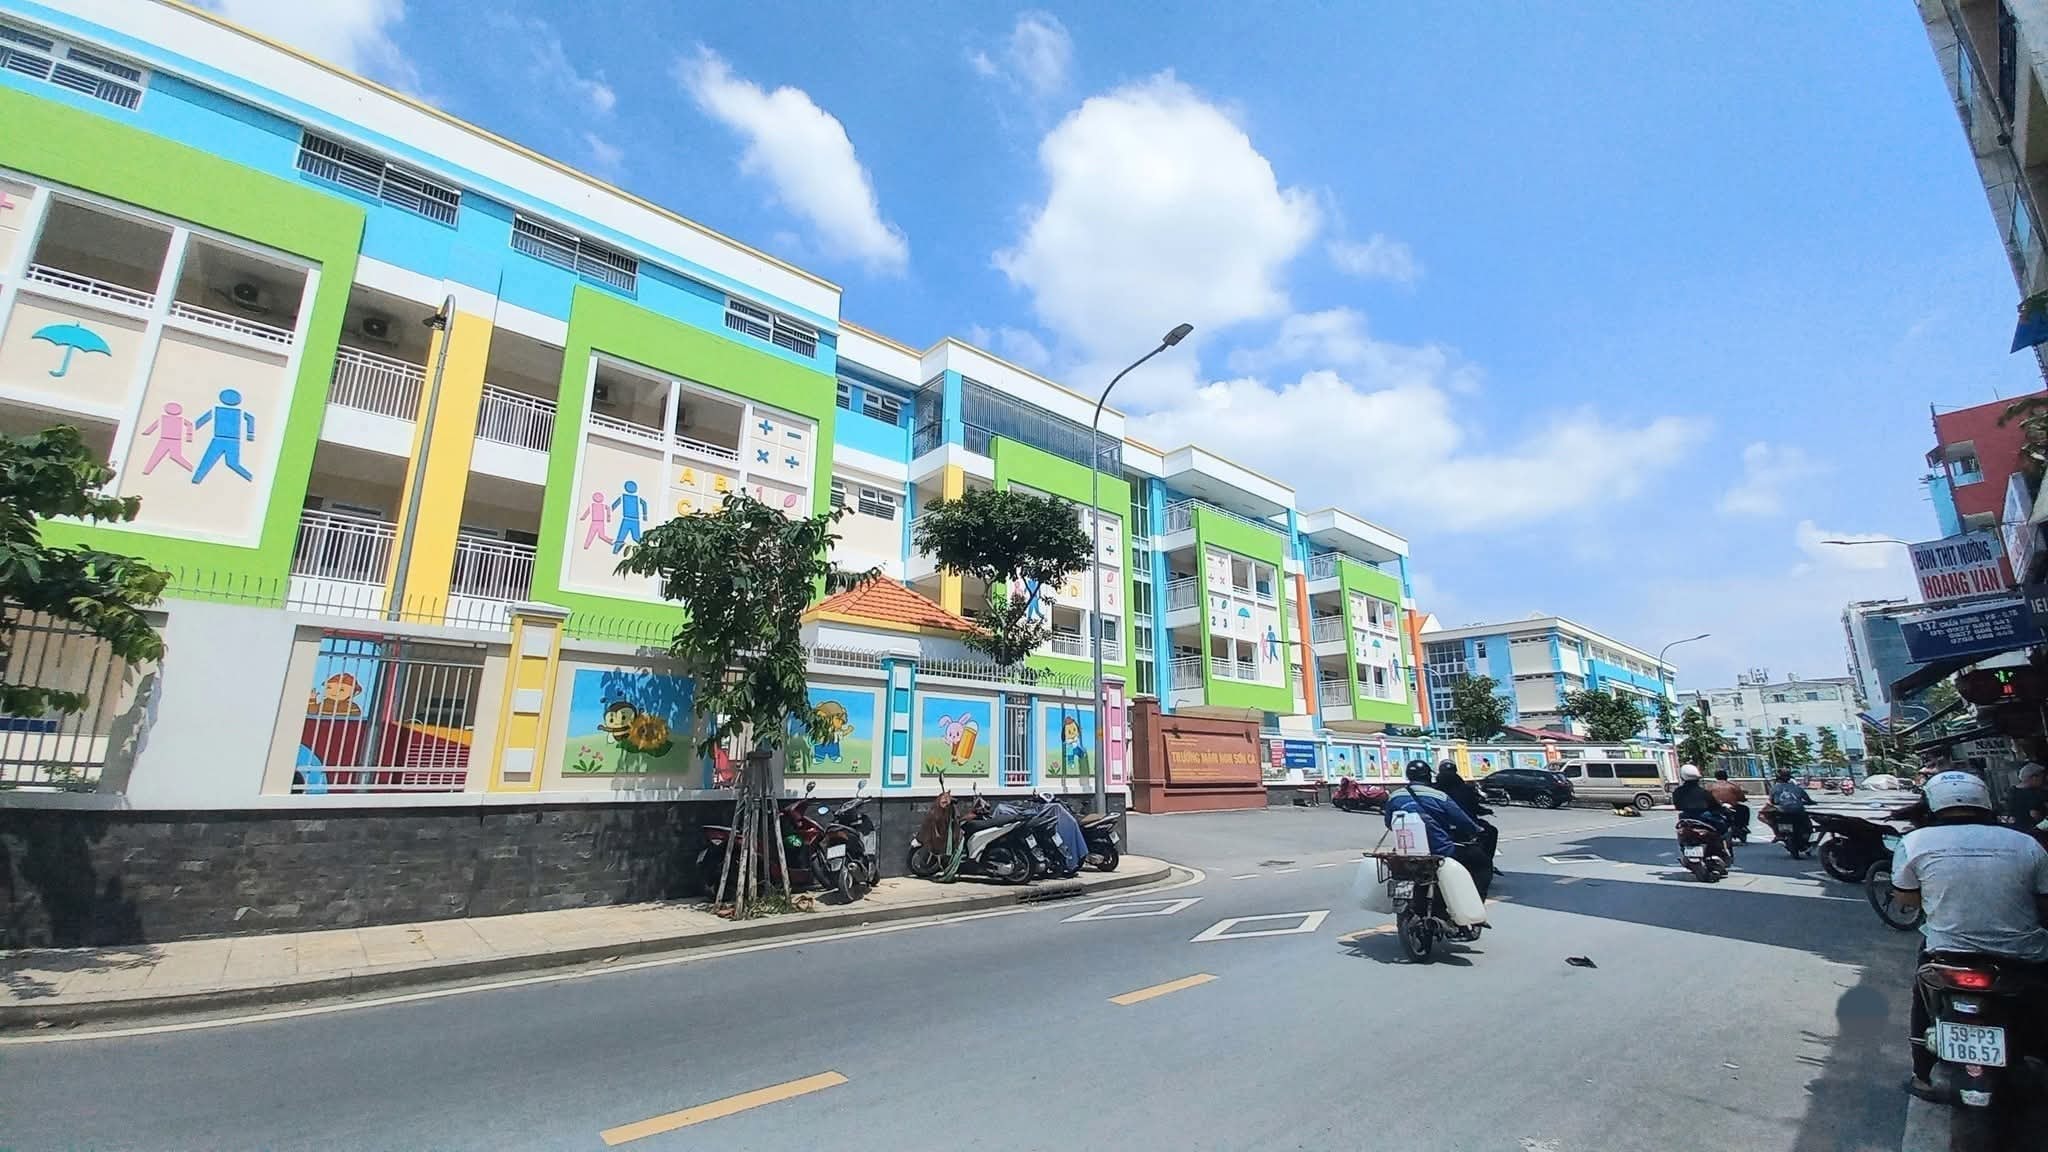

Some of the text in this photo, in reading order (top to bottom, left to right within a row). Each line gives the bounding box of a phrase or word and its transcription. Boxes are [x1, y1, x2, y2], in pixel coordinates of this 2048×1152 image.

[680, 467, 728, 492] A B
[677, 500, 691, 517] C
[1935, 545, 1957, 570] THỊT
[1922, 564, 2001, 599] HOÀNG VĂN
[1950, 1026, 1996, 1045] 59-P3
[1948, 1041, 2001, 1063] 186.57
